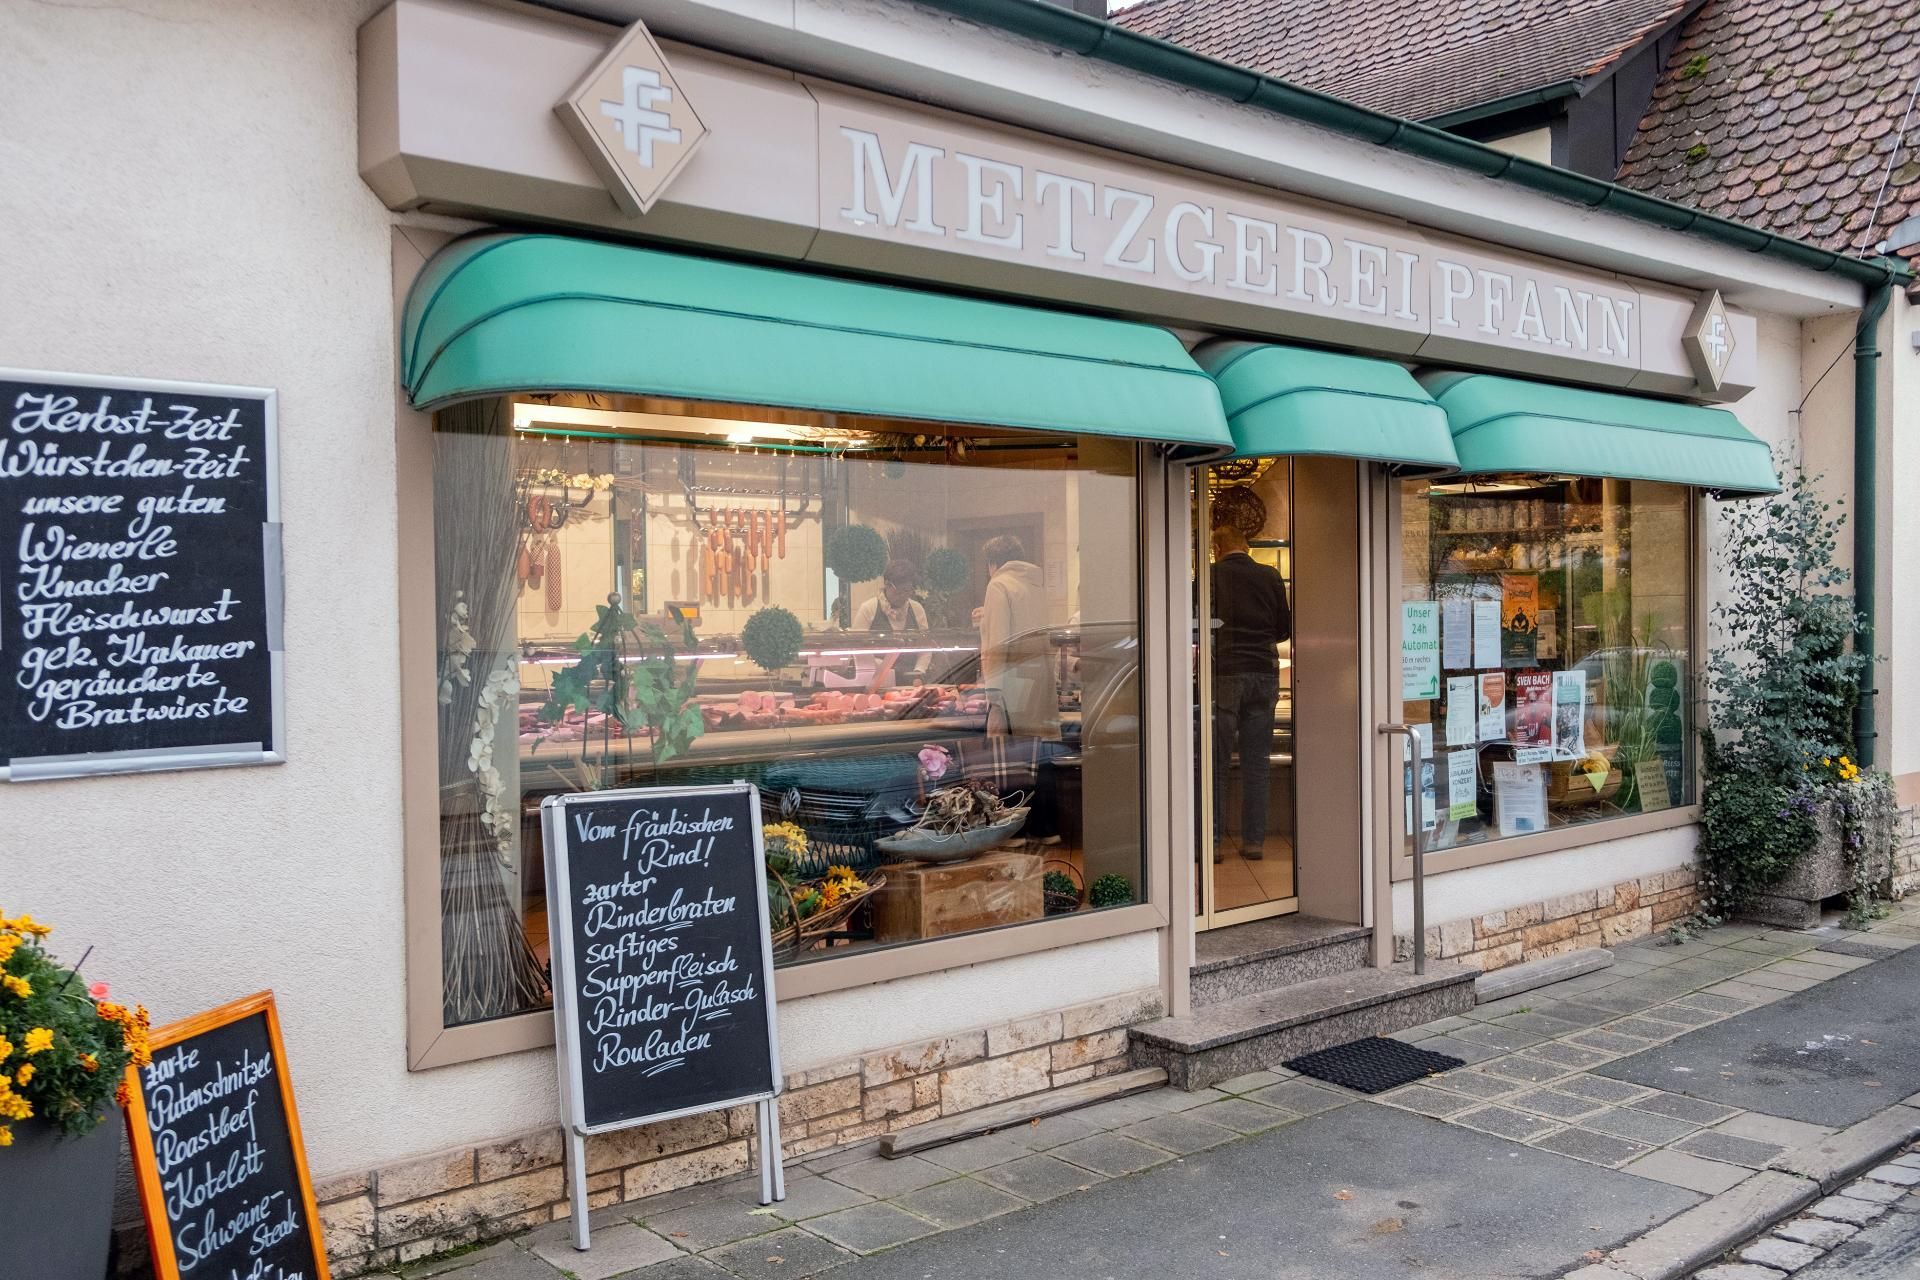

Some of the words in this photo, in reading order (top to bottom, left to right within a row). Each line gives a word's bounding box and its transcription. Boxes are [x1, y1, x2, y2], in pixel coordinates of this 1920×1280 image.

[839, 125, 1419, 321] METZGEREI
[1436, 258, 1634, 360] PFANN
[12, 392, 243, 441] Herbst-Zeit
[0, 438, 250, 479] Würstchen-Zeit
[21, 493, 125, 516] unsere
[127, 485, 227, 537] guten
[18, 522, 178, 562] Wienerle
[17, 563, 170, 601] Knacker
[20, 588, 242, 641] Fleischwurst
[1407, 607, 1431, 618] Unser
[1412, 623, 1427, 634] 24h
[16, 636, 98, 690] gek.
[107, 634, 255, 669] Krakauer
[1402, 639, 1437, 651] Automat
[28, 666, 219, 721] geräucherte
[1517, 676, 1532, 686] SVEN
[1533, 674, 1550, 685] BACH
[56, 686, 248, 729] Bratwürste
[575, 811, 616, 843] Vom
[620, 807, 734, 861] fränkischen
[638, 836, 715, 875] Rind!
[582, 871, 657, 905] zarter
[584, 886, 736, 937] Rinderbraten
[583, 946, 738, 1006] Suppenfleisch
[585, 931, 679, 974] saftiges
[594, 1029, 711, 1074] Rouladen
[148, 1048, 272, 1131] Putenschnitzel
[156, 1088, 258, 1175] Roastbeef
[164, 1140, 266, 1221] Kotelett
[177, 1190, 284, 1271] Schweine-
[249, 1199, 299, 1255] Steak
